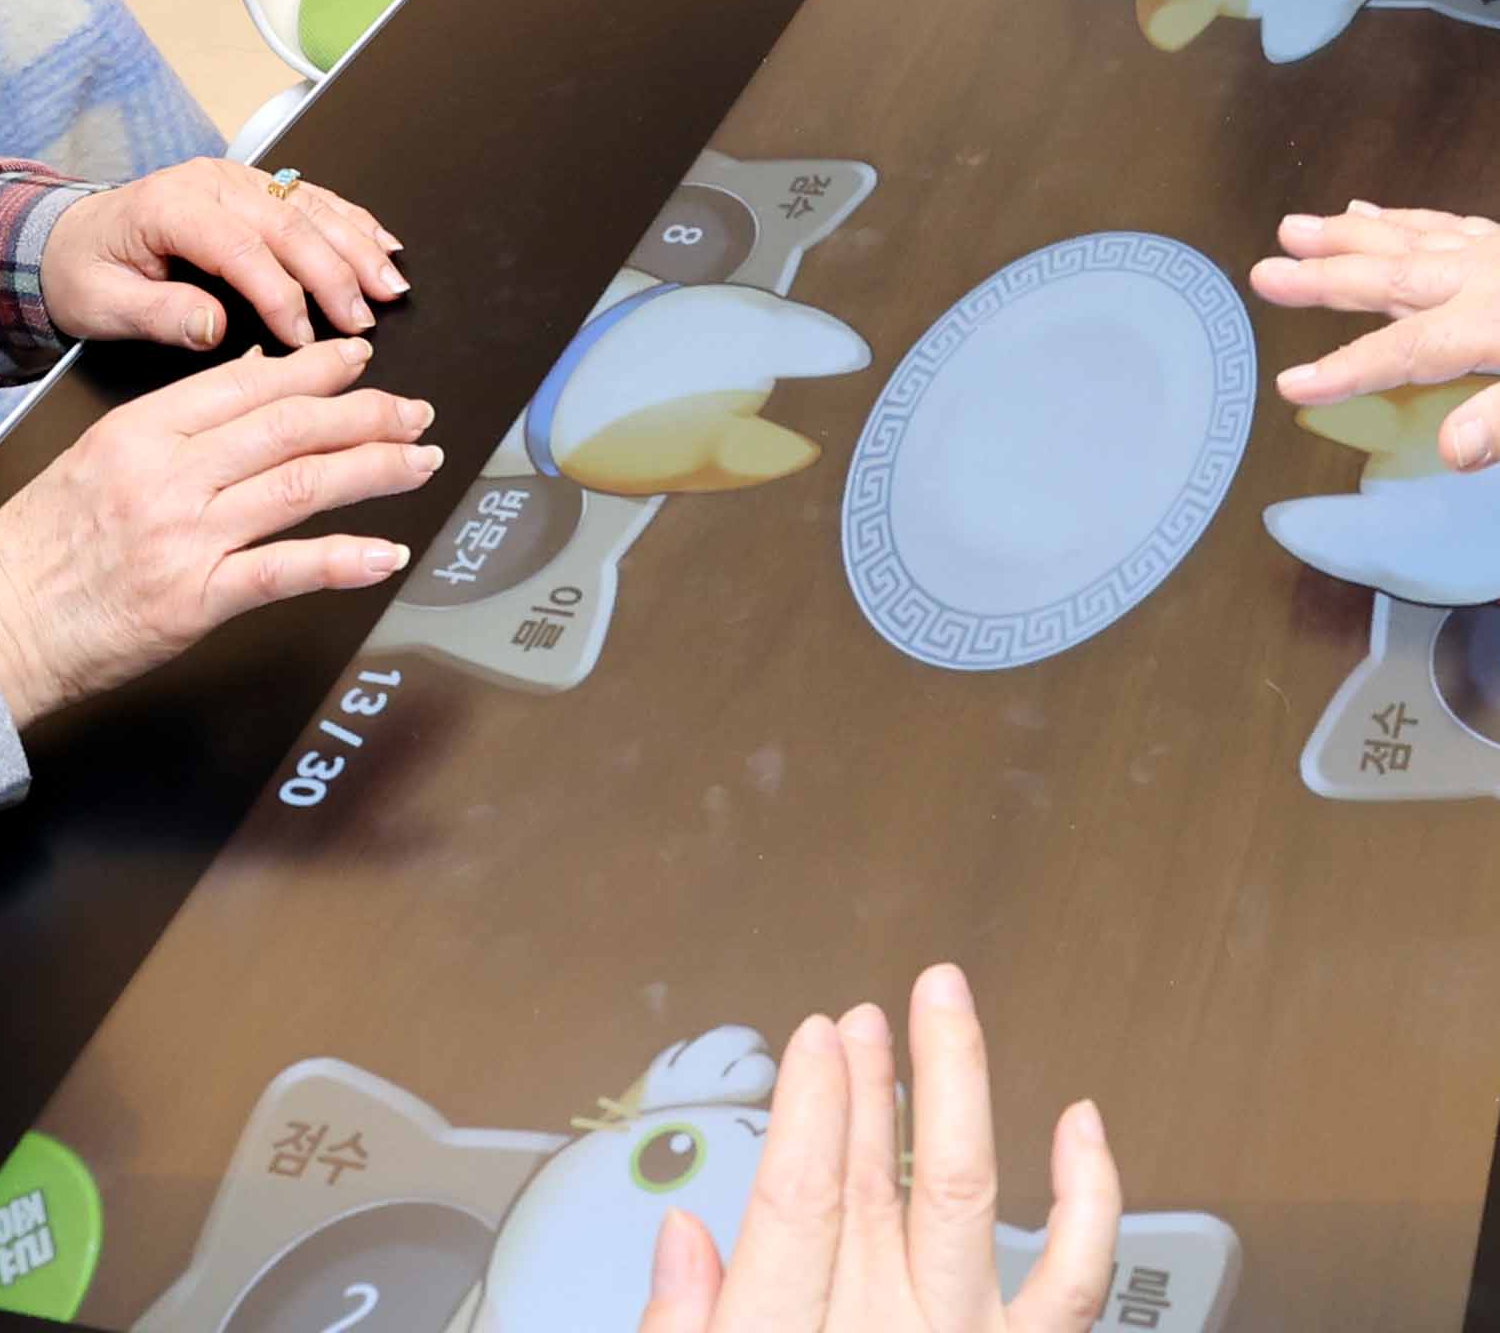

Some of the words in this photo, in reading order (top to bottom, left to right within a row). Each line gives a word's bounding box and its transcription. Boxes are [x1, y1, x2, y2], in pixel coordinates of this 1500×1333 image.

[777, 174, 832, 220] 점수
[662, 224, 704, 246] 8
[432, 489, 532, 585] 방문자
[510, 585, 584, 653] 이름
[339, 669, 402, 716] 13
[1359, 700, 1419, 776] 점수
[277, 750, 346, 808] 30
[267, 1120, 368, 1186] 점수
